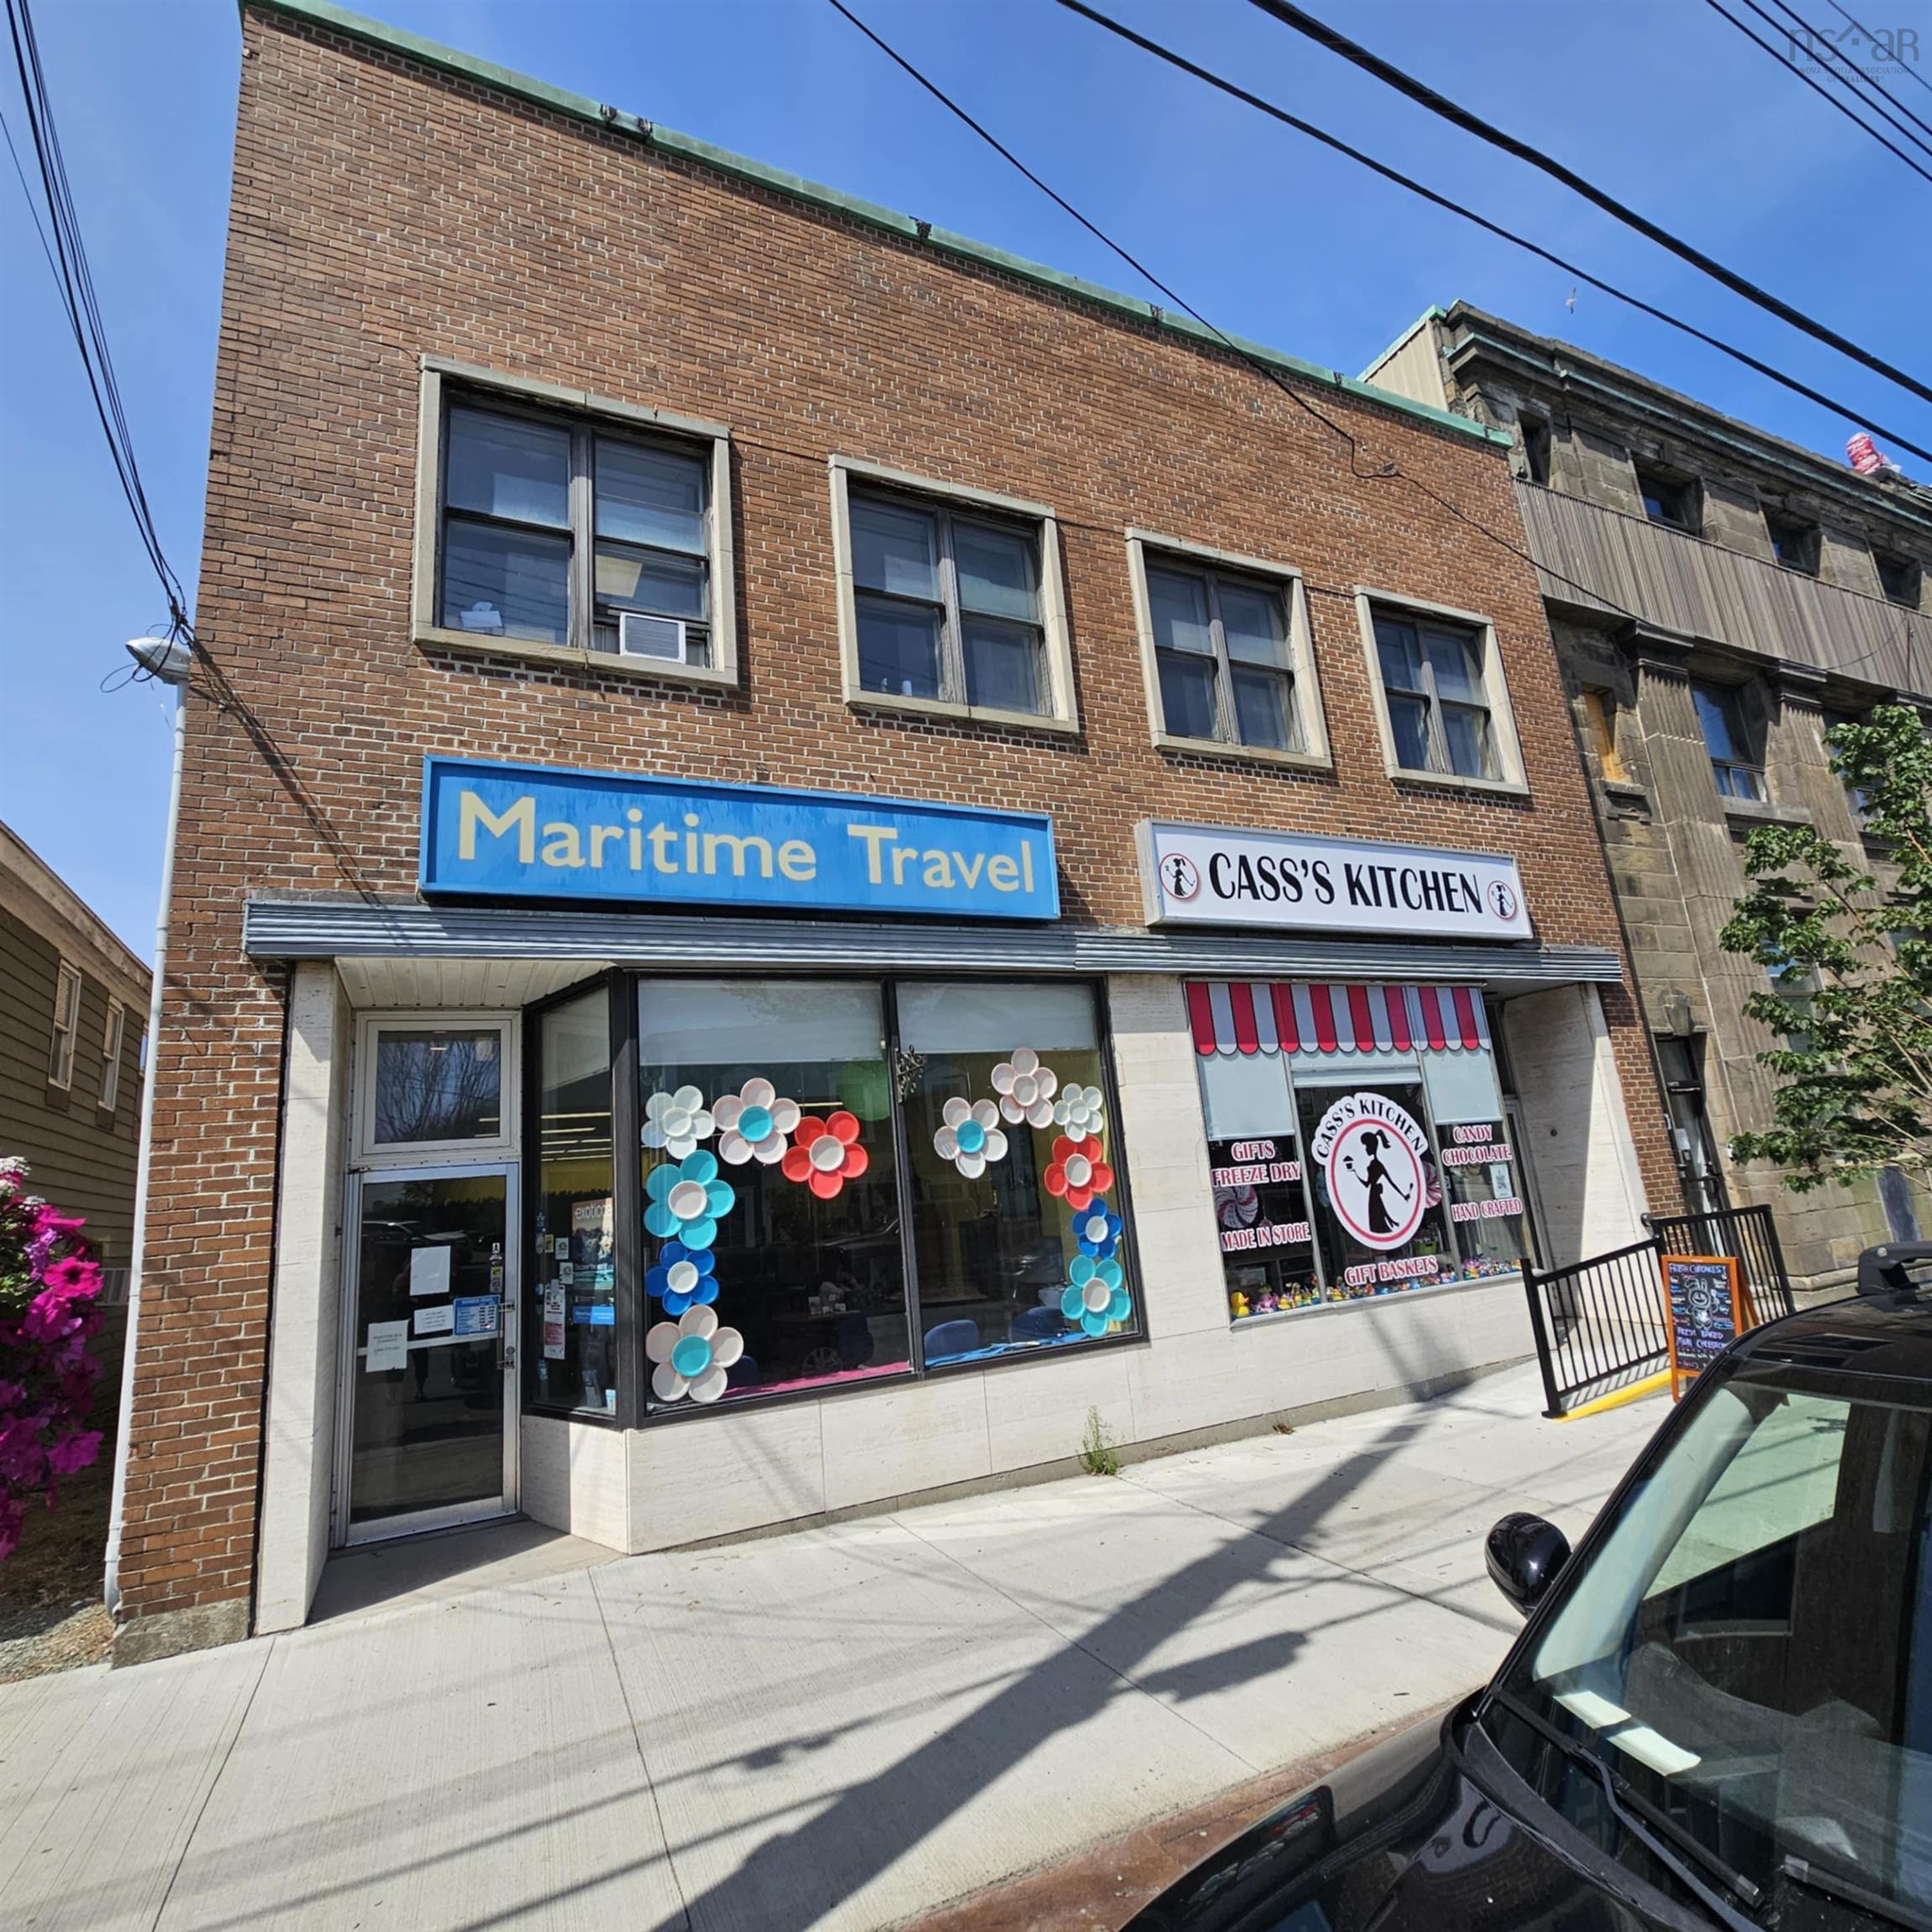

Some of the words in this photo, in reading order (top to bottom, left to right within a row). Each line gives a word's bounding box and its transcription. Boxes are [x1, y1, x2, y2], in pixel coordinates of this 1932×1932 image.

[458, 790, 817, 882] Maritime
[847, 823, 1034, 893] Travel
[1208, 851, 1335, 905] CASS'S
[1343, 862, 1484, 914] KITCHEN
[1317, 1102, 1356, 1158] CASS'S
[1359, 1098, 1424, 1151] KITCHEN
[1452, 1124, 1493, 1144] CANDY
[1231, 1140, 1275, 1161] GIFTS
[1441, 1144, 1513, 1166] CHOCOLATE
[1211, 1164, 1270, 1187] FREEZE
[1270, 1161, 1301, 1182] DRY
[1452, 1202, 1480, 1223] HAND
[1481, 1197, 1523, 1218] CRAFTED
[1221, 1228, 1257, 1252] MADE
[1256, 1226, 1272, 1247] IN
[1272, 1222, 1311, 1244] STORE
[1344, 1264, 1376, 1286] GIFT
[1378, 1255, 1438, 1281] BASKETS
